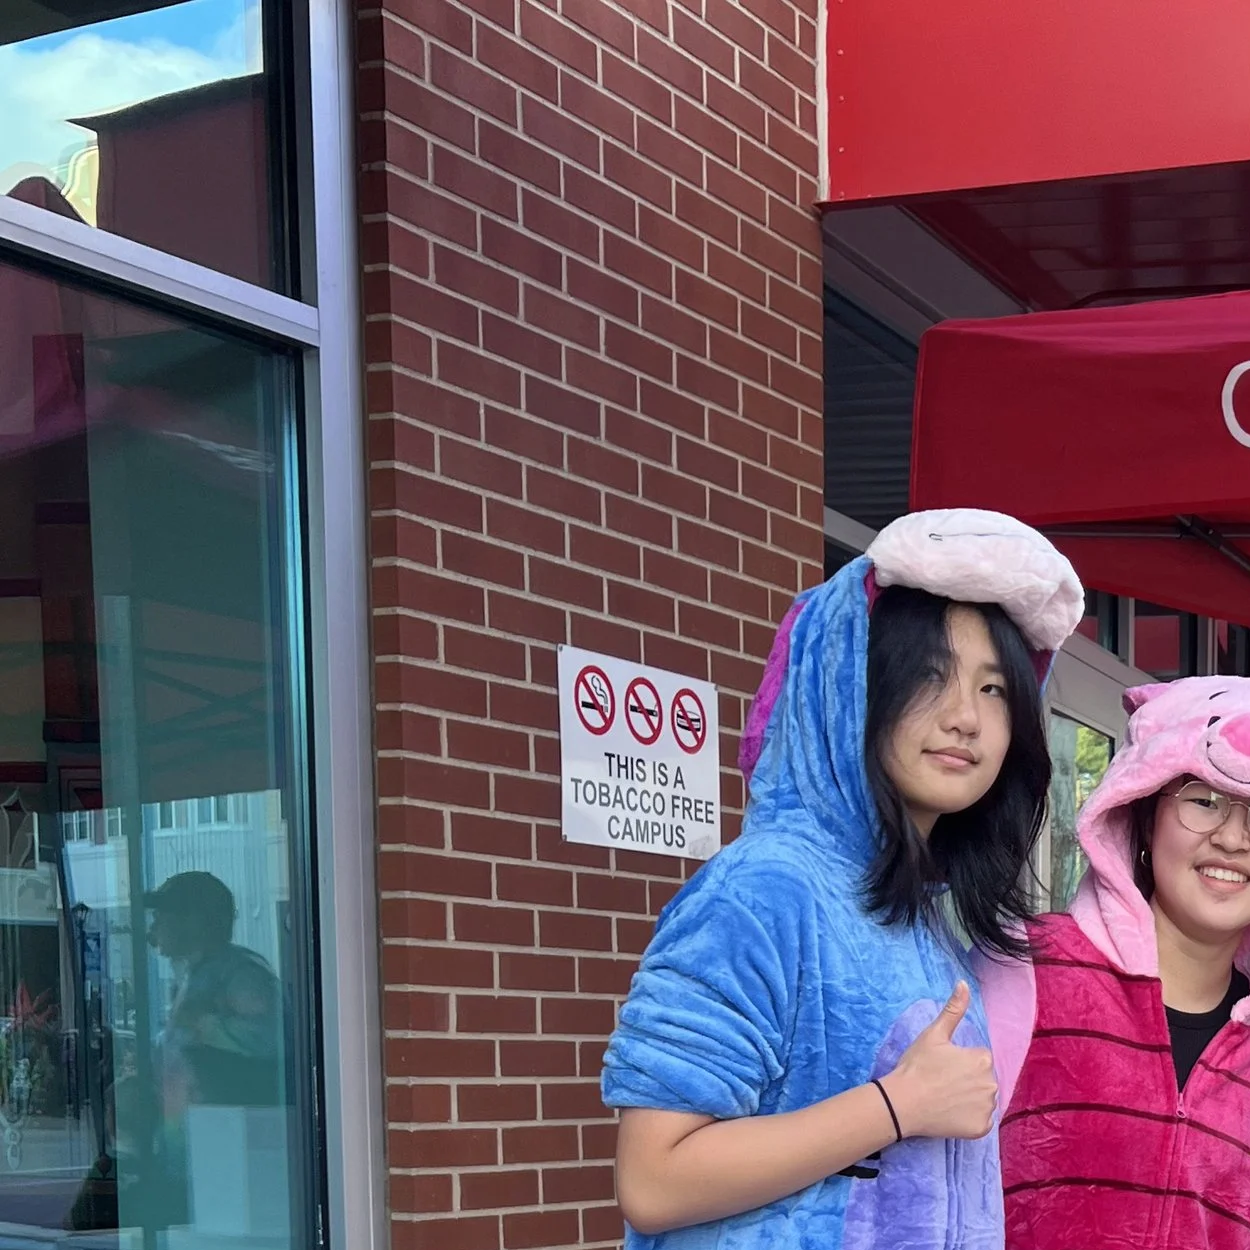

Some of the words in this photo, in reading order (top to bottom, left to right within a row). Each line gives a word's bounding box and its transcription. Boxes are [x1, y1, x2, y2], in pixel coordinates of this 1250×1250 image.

[604, 752, 647, 783] THIS
[652, 761, 669, 786] IS
[673, 766, 686, 790] A
[570, 778, 666, 816] TOBACCO
[671, 795, 715, 824] FREE
[607, 815, 686, 849] CAMPUS
